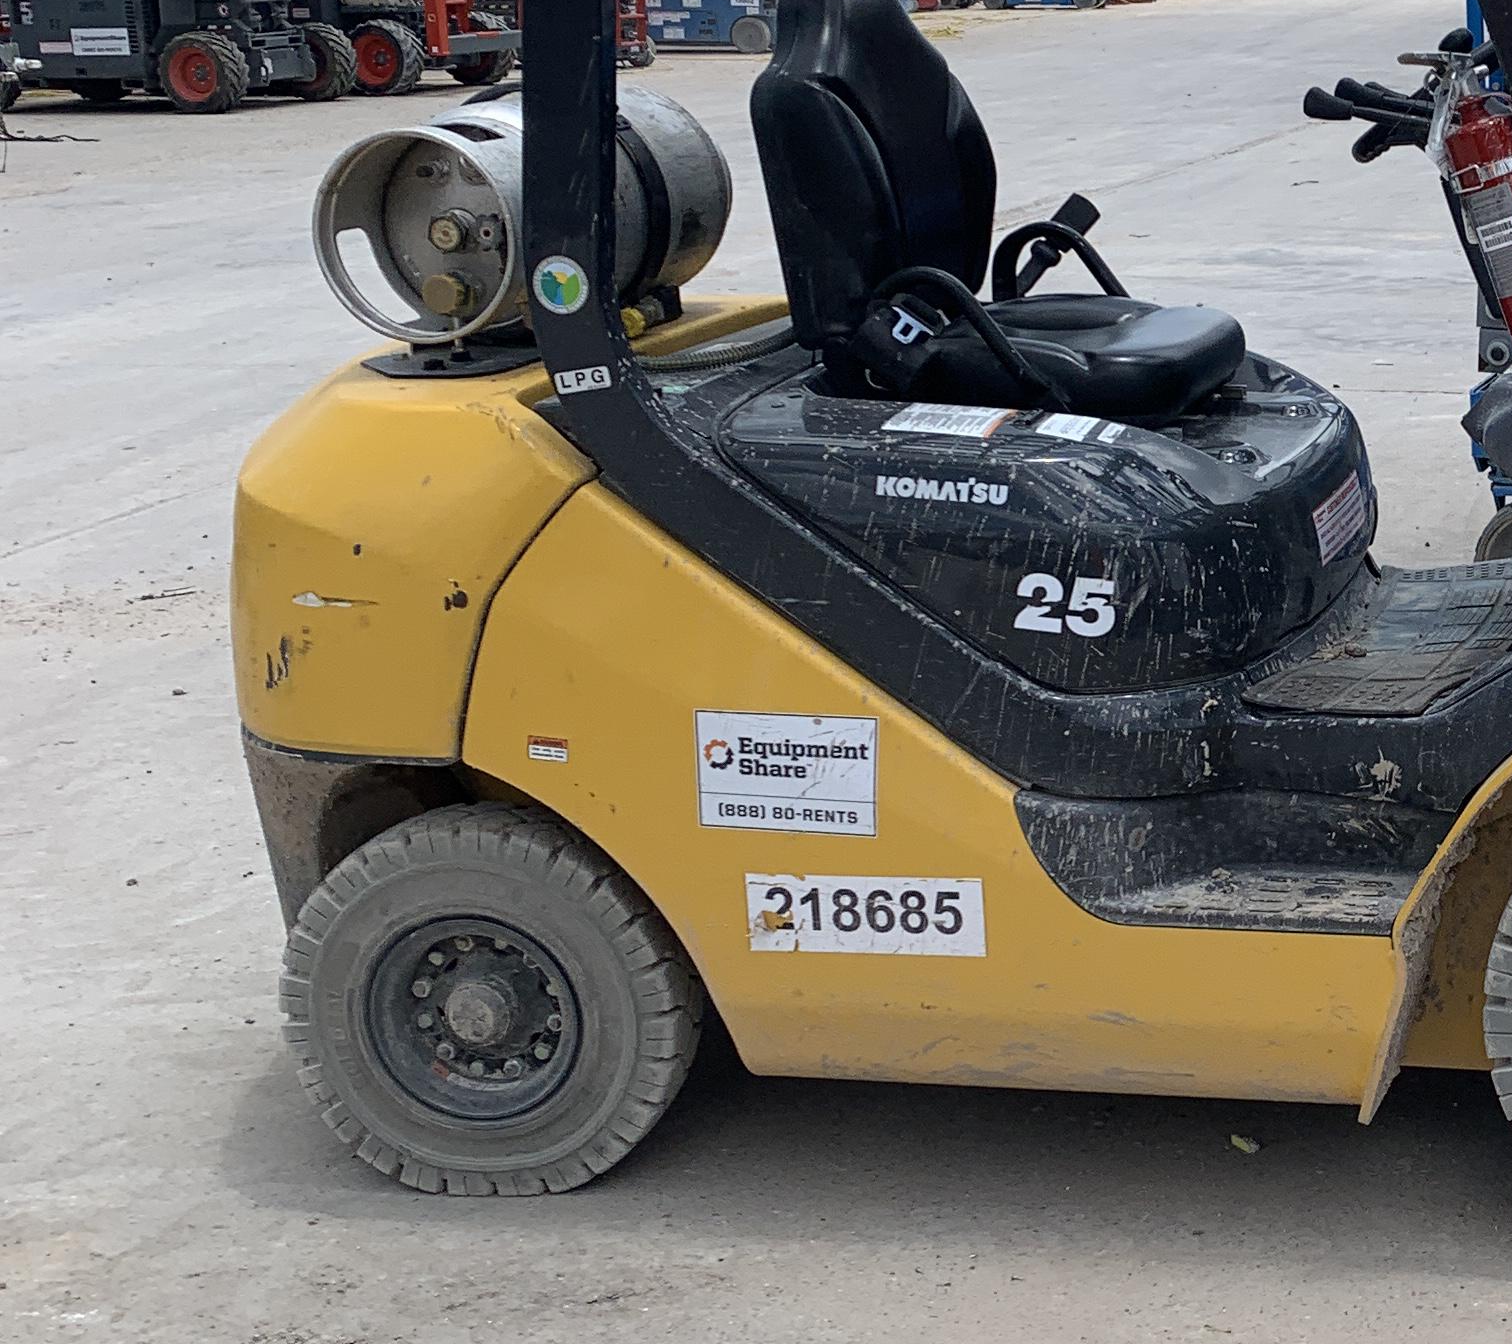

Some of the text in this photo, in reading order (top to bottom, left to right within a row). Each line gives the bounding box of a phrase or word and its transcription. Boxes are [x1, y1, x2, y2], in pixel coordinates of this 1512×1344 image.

[875, 475, 1009, 505] KOMATSU
[1012, 572, 1116, 638] 25
[738, 737, 869, 761] Equipment
[739, 760, 807, 778] Share
[718, 802, 858, 825] (888) 80-RENTS
[764, 886, 964, 936] 218685
